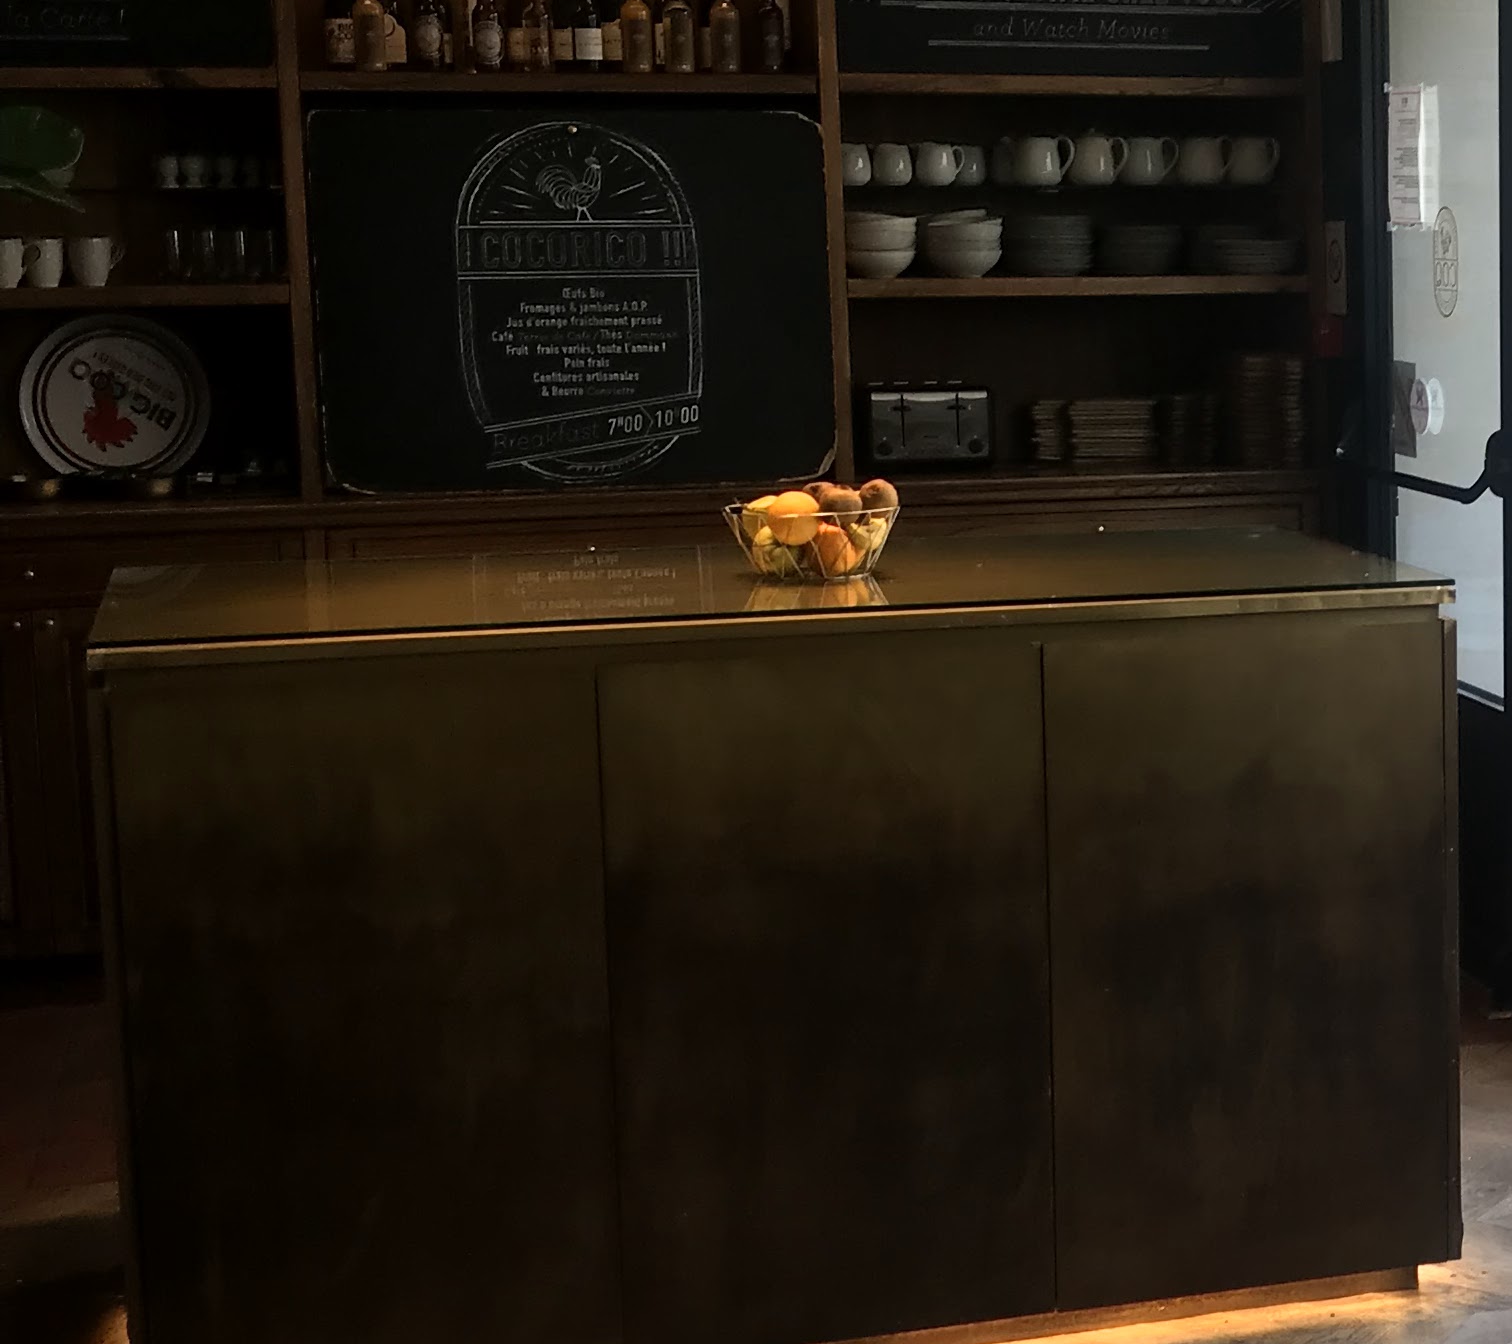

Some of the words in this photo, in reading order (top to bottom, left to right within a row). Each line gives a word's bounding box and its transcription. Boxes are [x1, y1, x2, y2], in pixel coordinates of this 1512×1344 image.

[1021, 17, 1089, 40] Watch
[1097, 17, 1169, 41] Movies
[480, 231, 648, 269] COCORICO
[590, 287, 606, 299] Bio
[519, 302, 566, 316] Fromages
[579, 301, 620, 316] jambons
[507, 317, 524, 328] Jus
[536, 343, 560, 356] frais
[596, 343, 623, 355] toute
[563, 357, 585, 369] Pain
[587, 356, 611, 369] frais
[533, 371, 584, 383] Confitures
[586, 370, 640, 383] artisanales
[551, 385, 584, 397] Beurre
